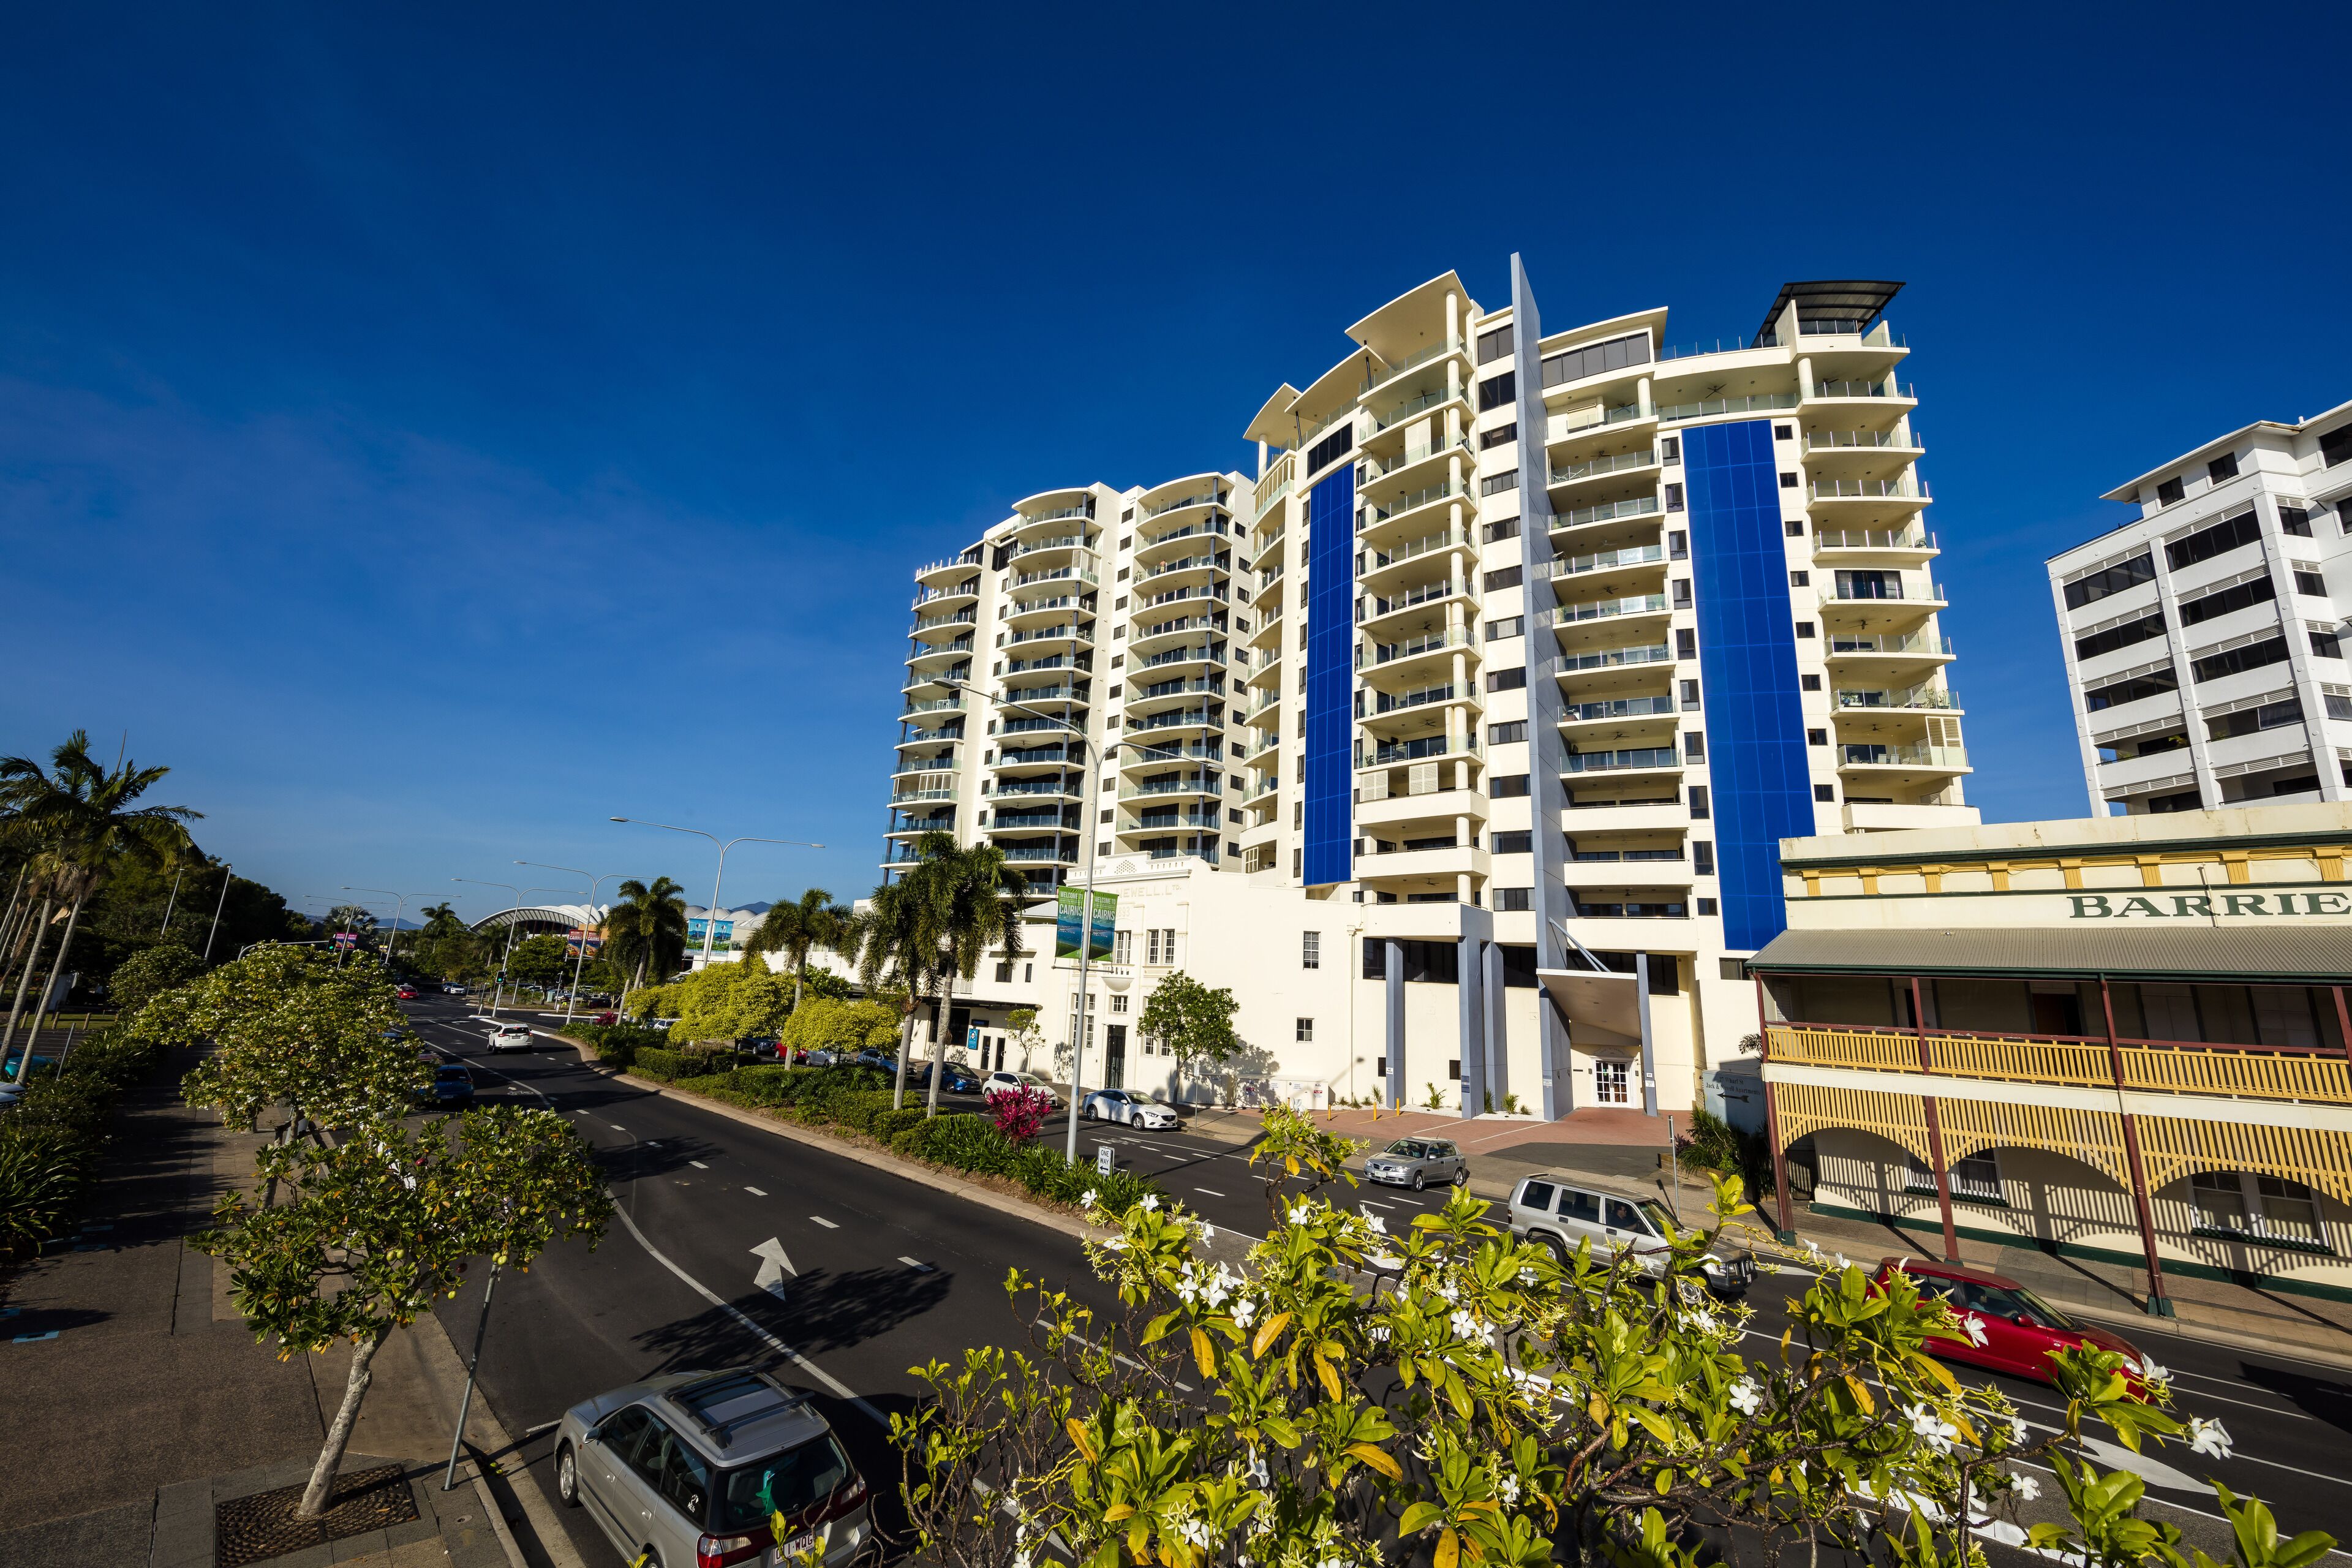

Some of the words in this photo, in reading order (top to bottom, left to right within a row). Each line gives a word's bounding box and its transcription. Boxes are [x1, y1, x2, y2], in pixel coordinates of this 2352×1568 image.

[1059, 903, 1083, 916] CAIRNS
[2066, 892, 2352, 918] BARRIE
[1093, 908, 1115, 921] CAIRNS
[1735, 1087, 1761, 1095] Apartments
